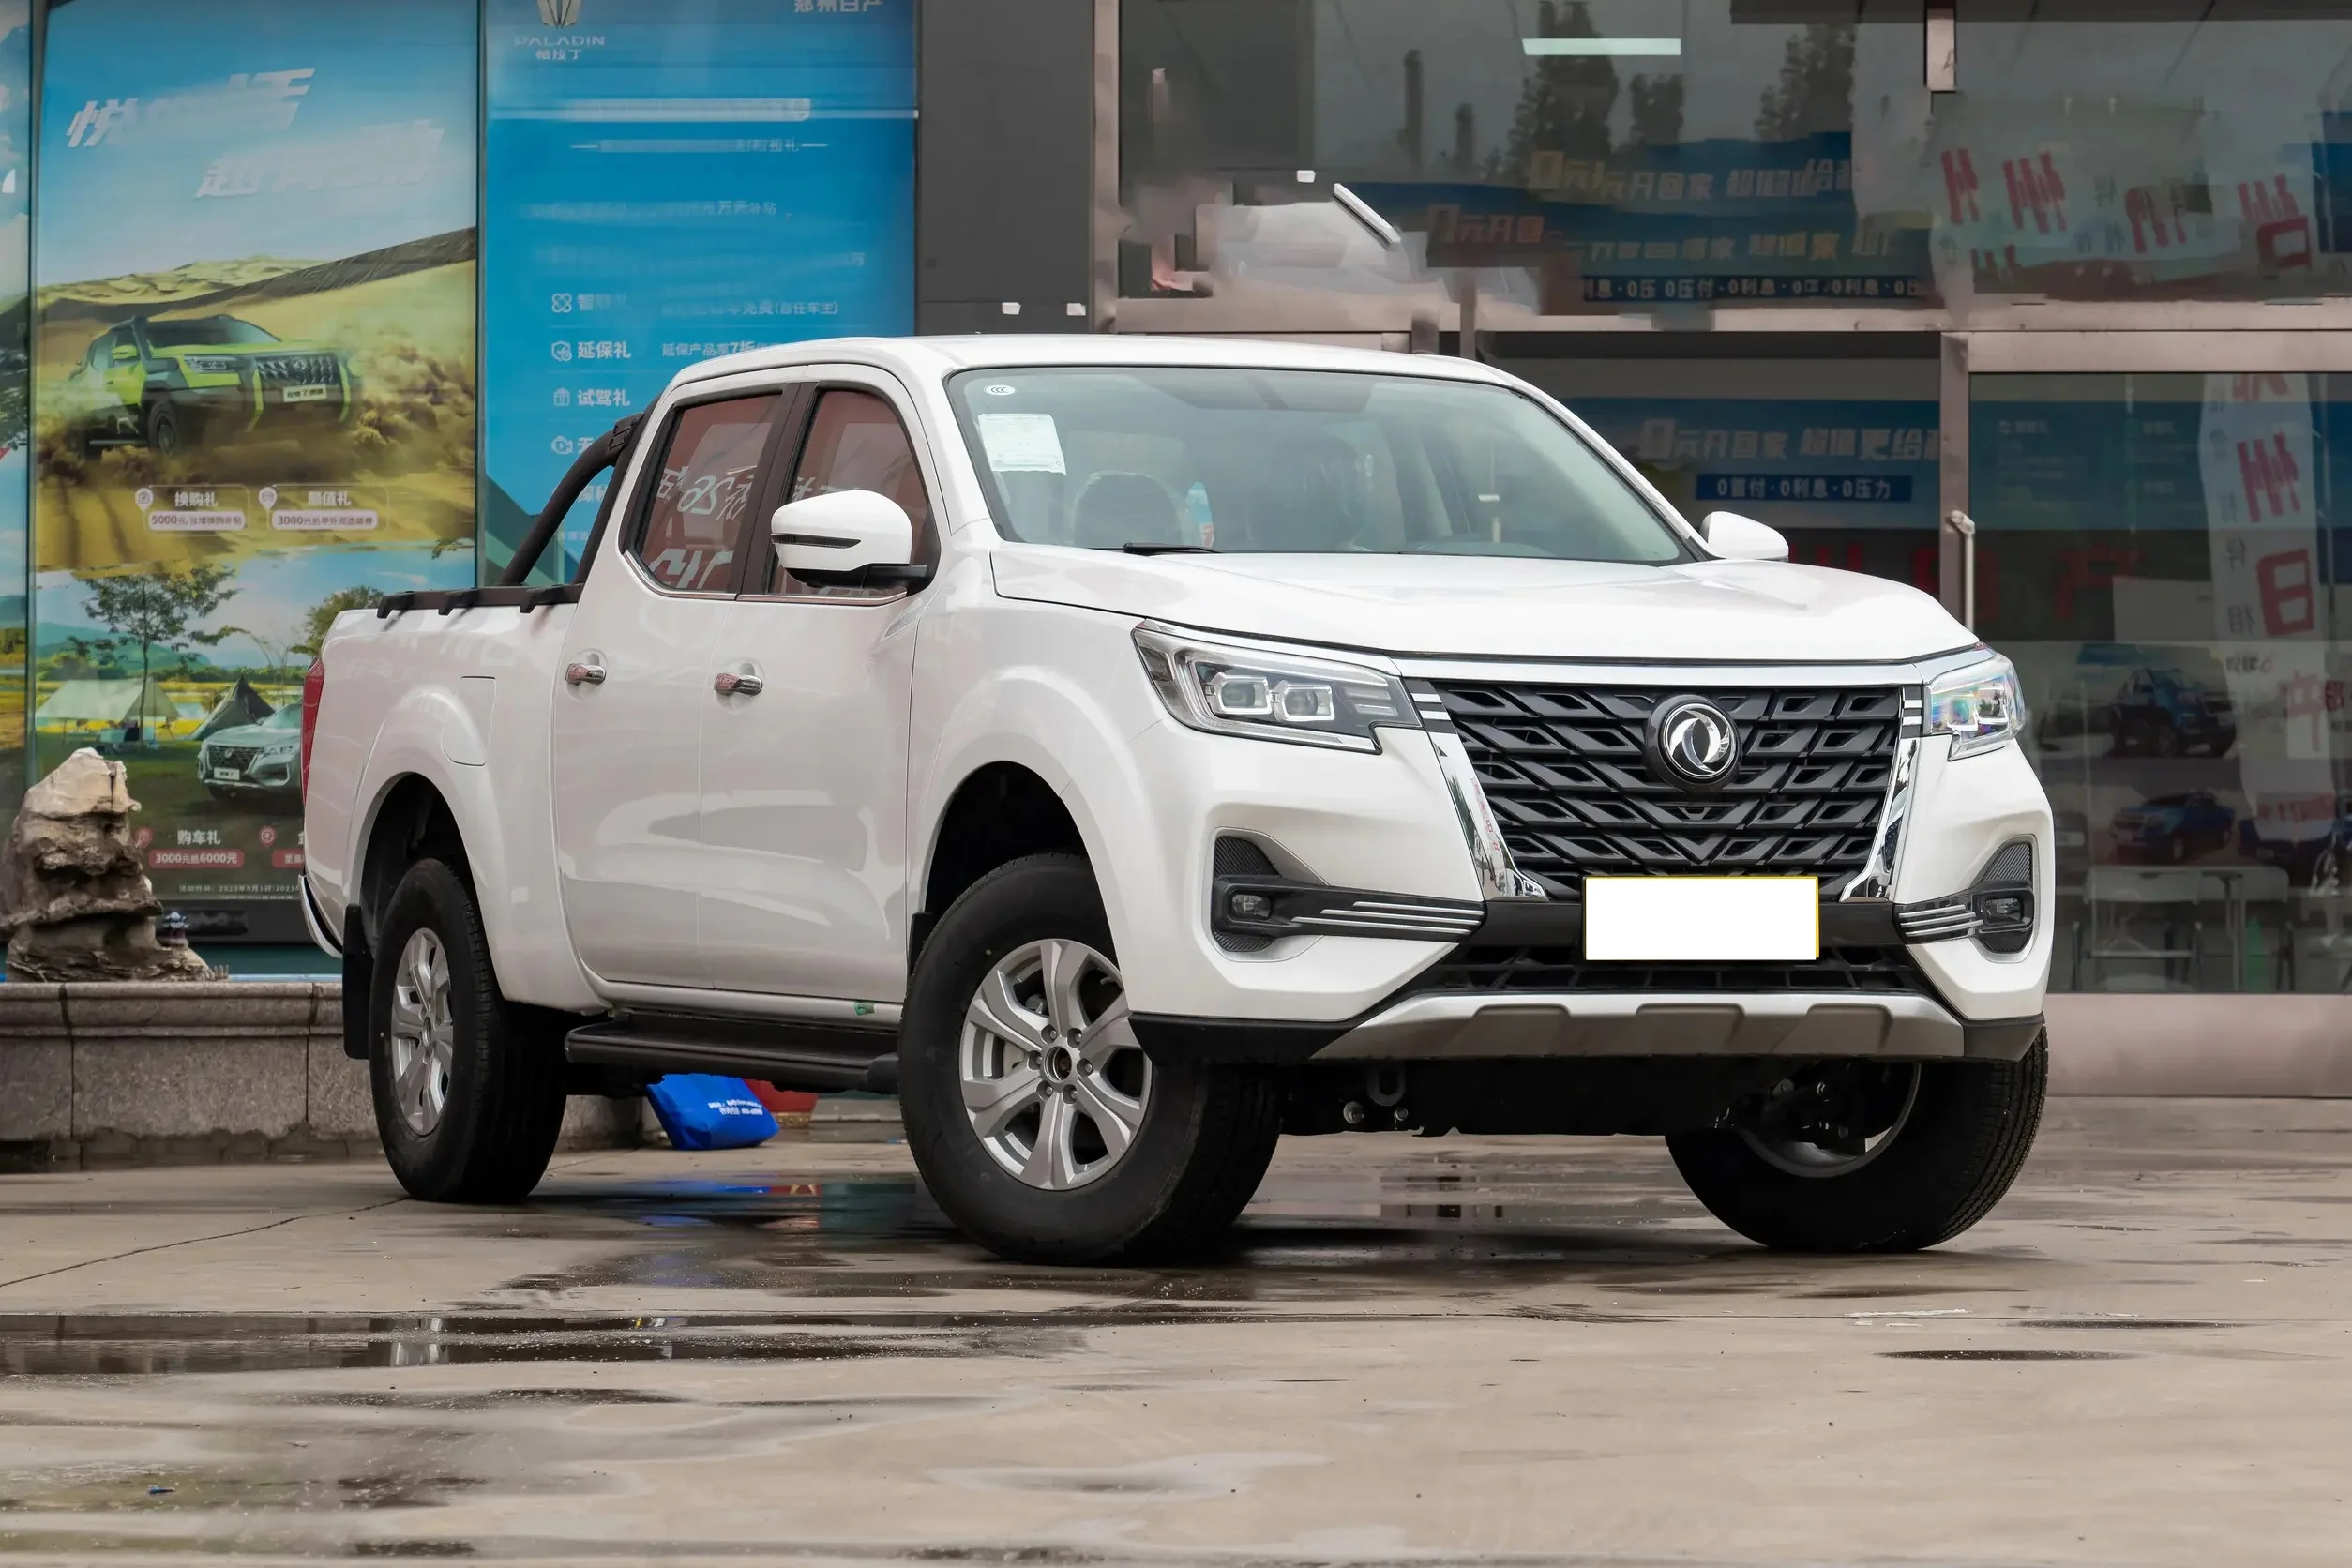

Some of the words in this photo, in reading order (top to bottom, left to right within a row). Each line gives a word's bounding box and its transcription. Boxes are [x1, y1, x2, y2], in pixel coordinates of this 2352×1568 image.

[516, 35, 606, 46] PALADIN
[577, 340, 632, 359] 延保礼
[577, 388, 631, 407] 试驾礼
[177, 829, 222, 846] 购车礼
